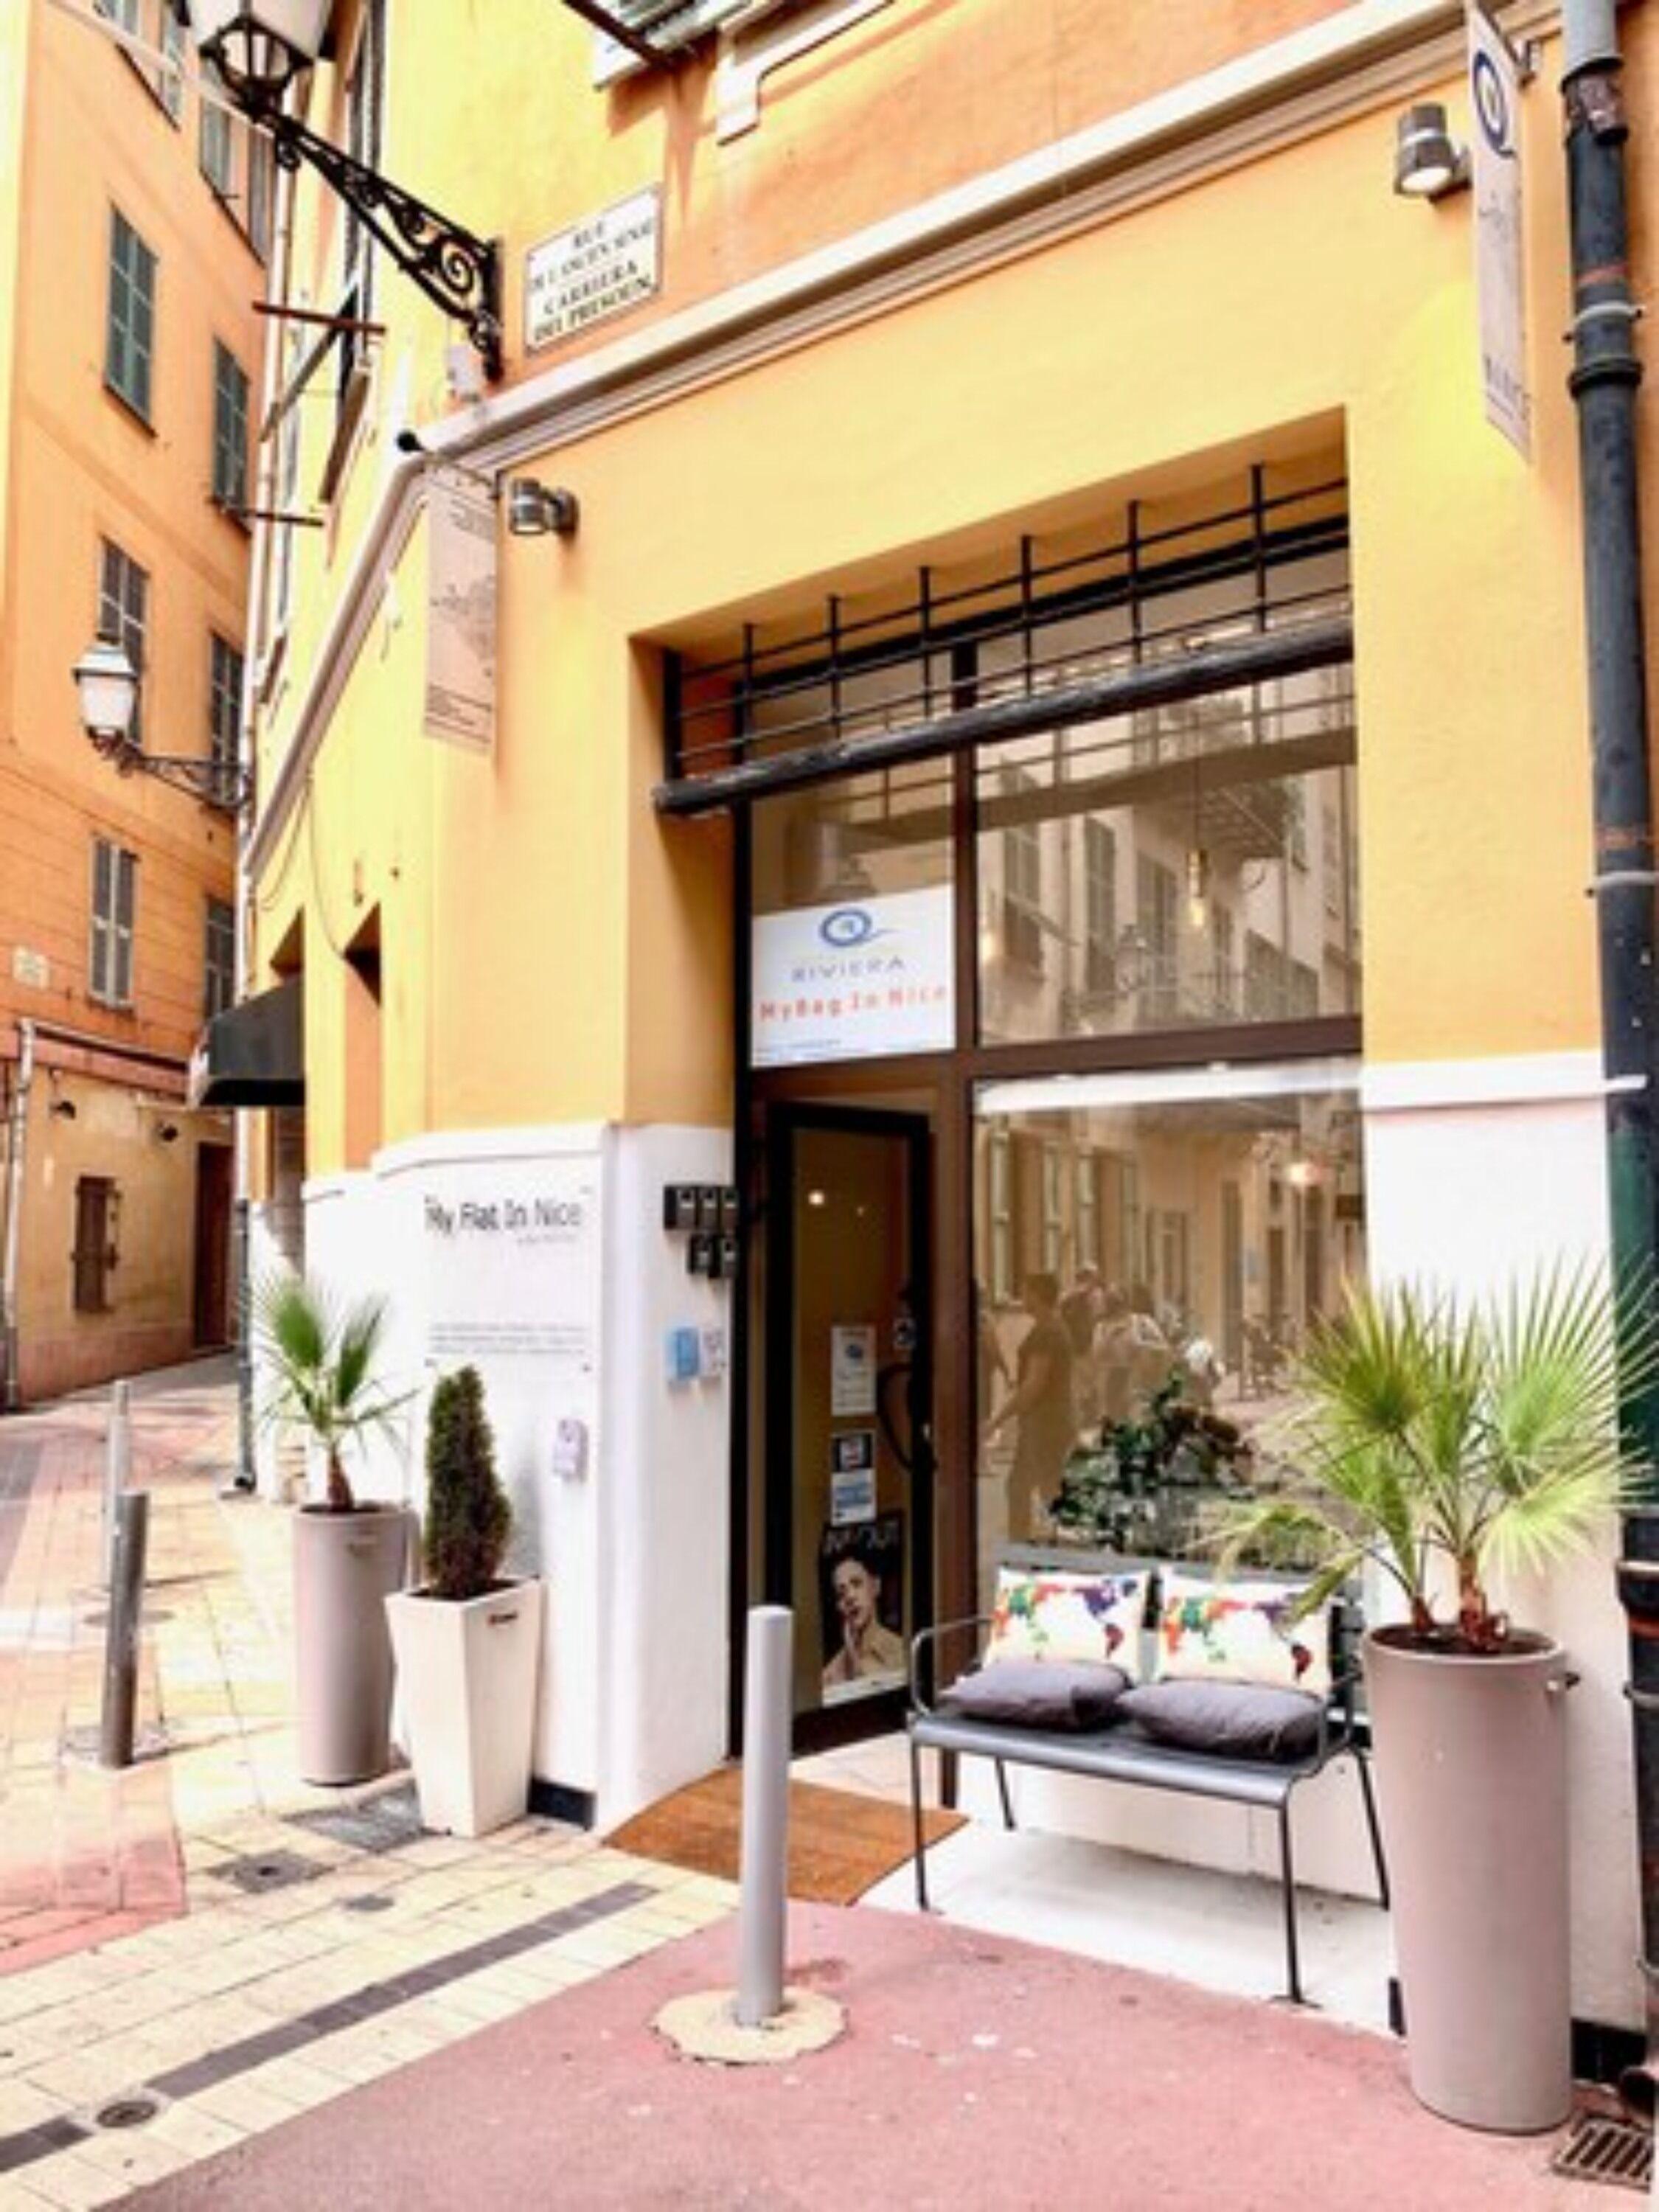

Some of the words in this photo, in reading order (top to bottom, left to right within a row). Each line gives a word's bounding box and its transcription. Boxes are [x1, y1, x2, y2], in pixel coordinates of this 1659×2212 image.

[573, 220, 605, 249] RUE
[791, 956, 905, 982] RIVIERA
[460, 1202, 500, 1231] Flat
[504, 1199, 528, 1229] In
[534, 1197, 581, 1227] Nice
